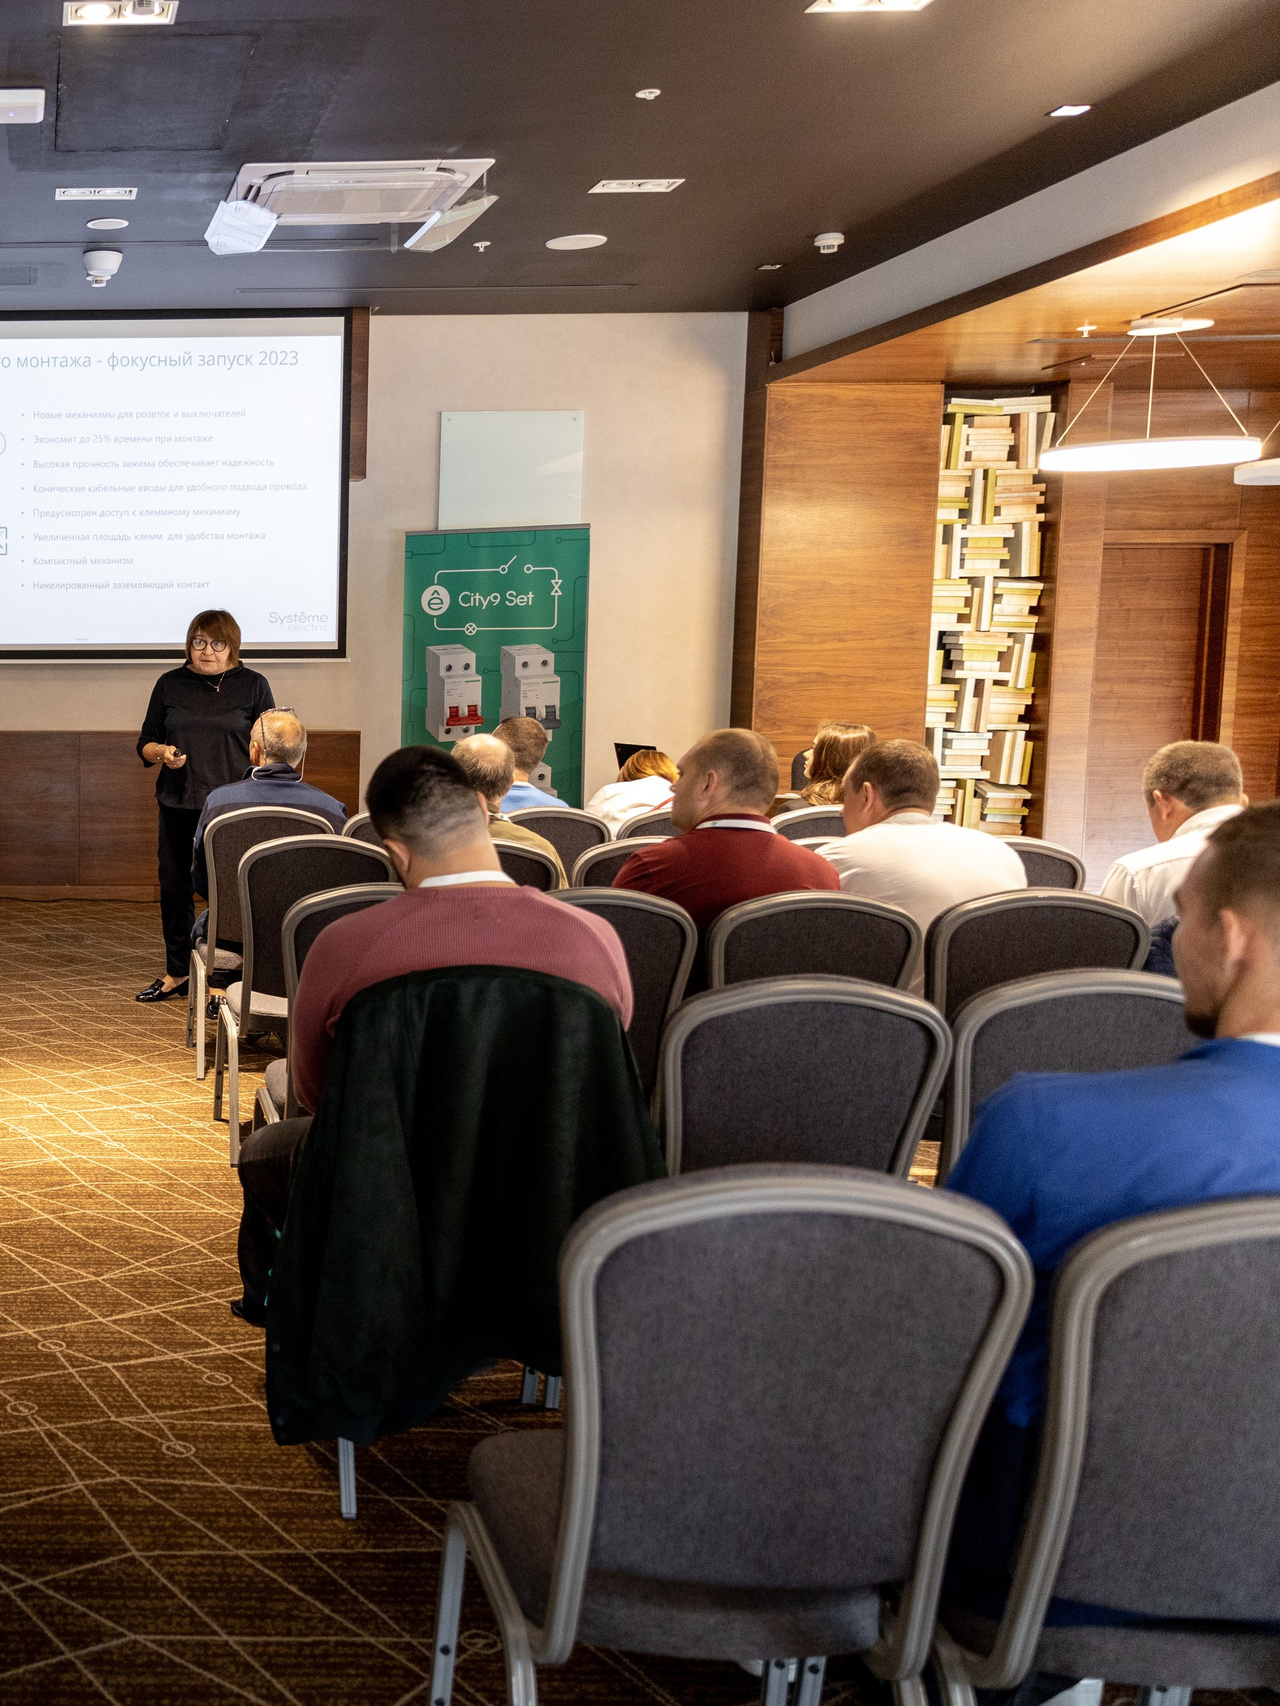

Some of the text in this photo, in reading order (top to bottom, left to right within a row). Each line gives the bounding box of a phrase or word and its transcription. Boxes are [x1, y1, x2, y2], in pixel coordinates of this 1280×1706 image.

[16, 355, 92, 369] монтажа
[107, 350, 193, 372] фокусный
[197, 354, 254, 372] запуск
[258, 350, 299, 366] 2023
[32, 410, 63, 420] Новые
[64, 411, 116, 420] механизмы
[116, 411, 134, 420] для
[135, 411, 171, 421] розеток
[181, 408, 247, 419] выключателей
[32, 434, 214, 445] Экономит до 25% времени при монтаже
[32, 458, 275, 471] Высокая прочность зажима обеспечивает надежность
[32, 482, 308, 494] Конические кабельные вводы для удобного подвода провода
[32, 508, 98, 520] Предусмотрен
[98, 509, 130, 519] доступ
[138, 509, 191, 519] клеммному
[192, 508, 242, 518] механизму
[32, 530, 266, 543] Увеличенная площадь клемм для удобства монтажа
[32, 556, 88, 566] Компактный
[32, 580, 210, 592] Никелированный заземляющий контакт
[458, 590, 535, 610] City9 Set
[268, 611, 329, 626] Systême
[287, 624, 328, 632] electric
